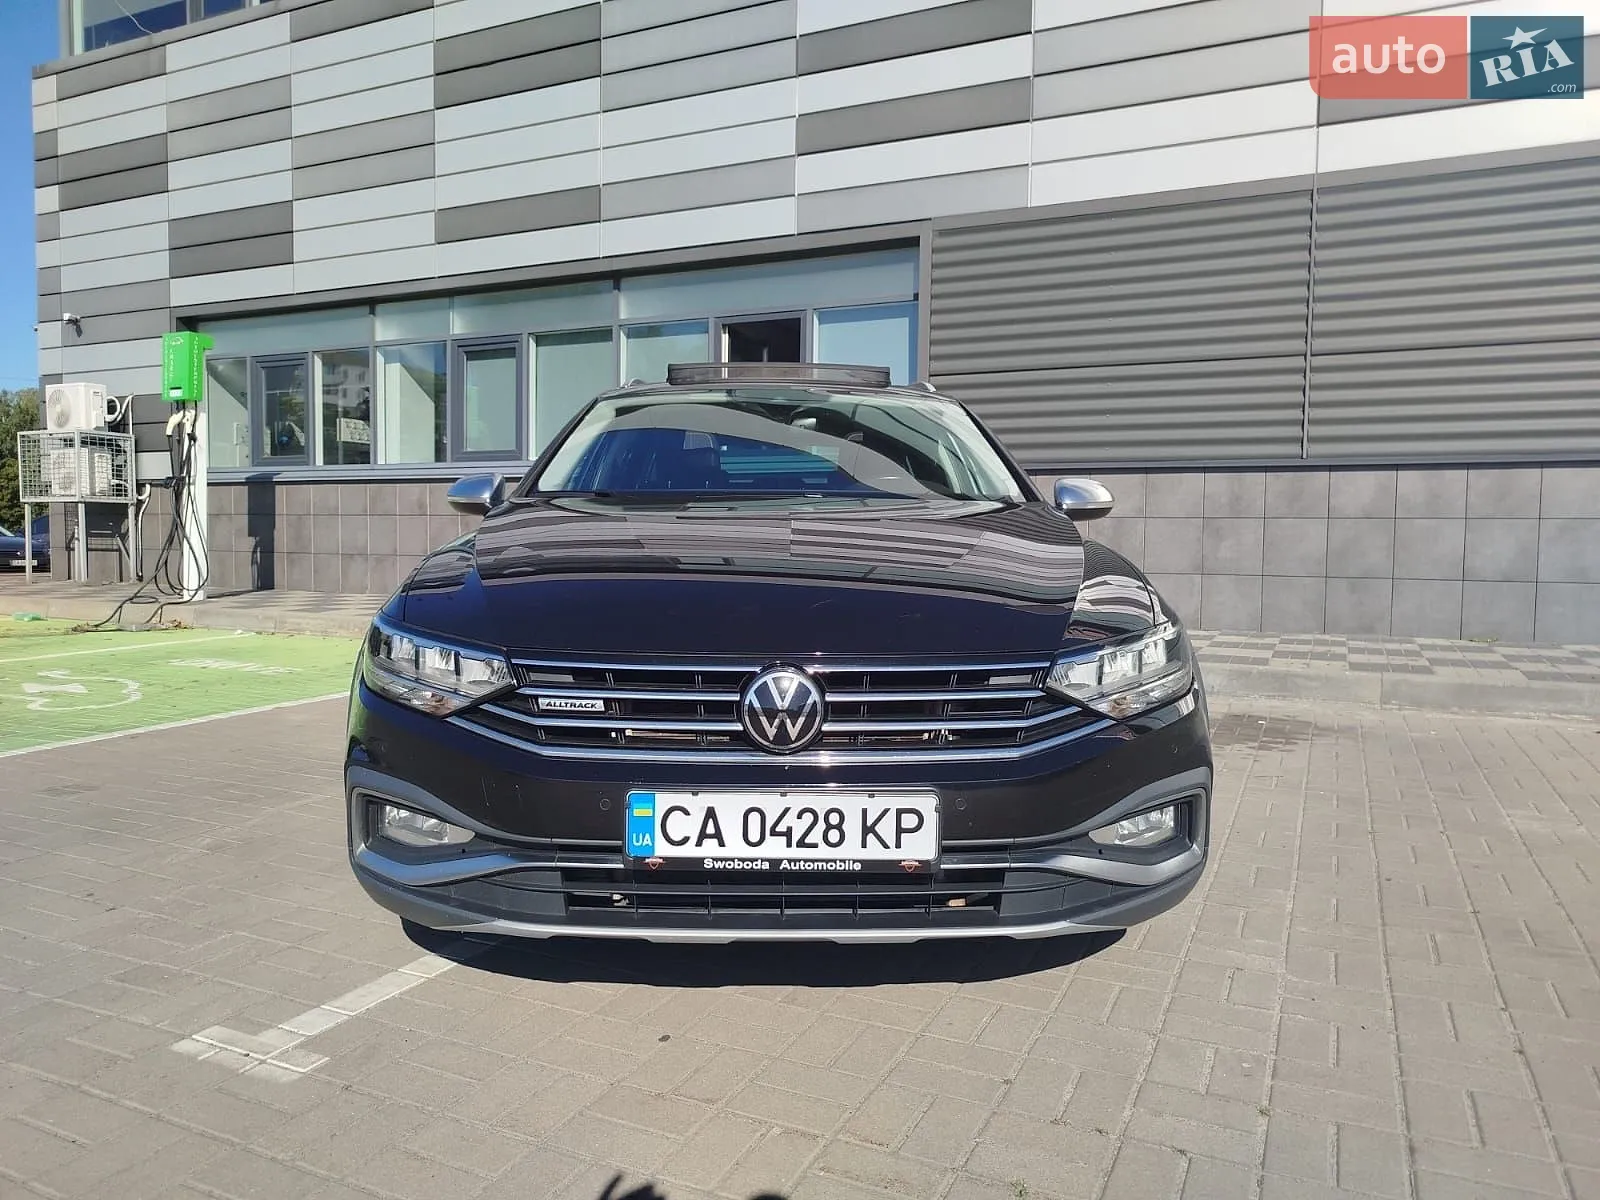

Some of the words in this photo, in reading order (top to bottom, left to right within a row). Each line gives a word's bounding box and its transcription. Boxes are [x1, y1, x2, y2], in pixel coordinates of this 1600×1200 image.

[545, 701, 599, 710] ALLTRACK
[660, 805, 726, 848] CA
[742, 806, 846, 849] 0428
[861, 807, 925, 850] KP
[632, 833, 653, 846] UA
[703, 858, 770, 870] Swoboda
[779, 859, 862, 871] Automobile
